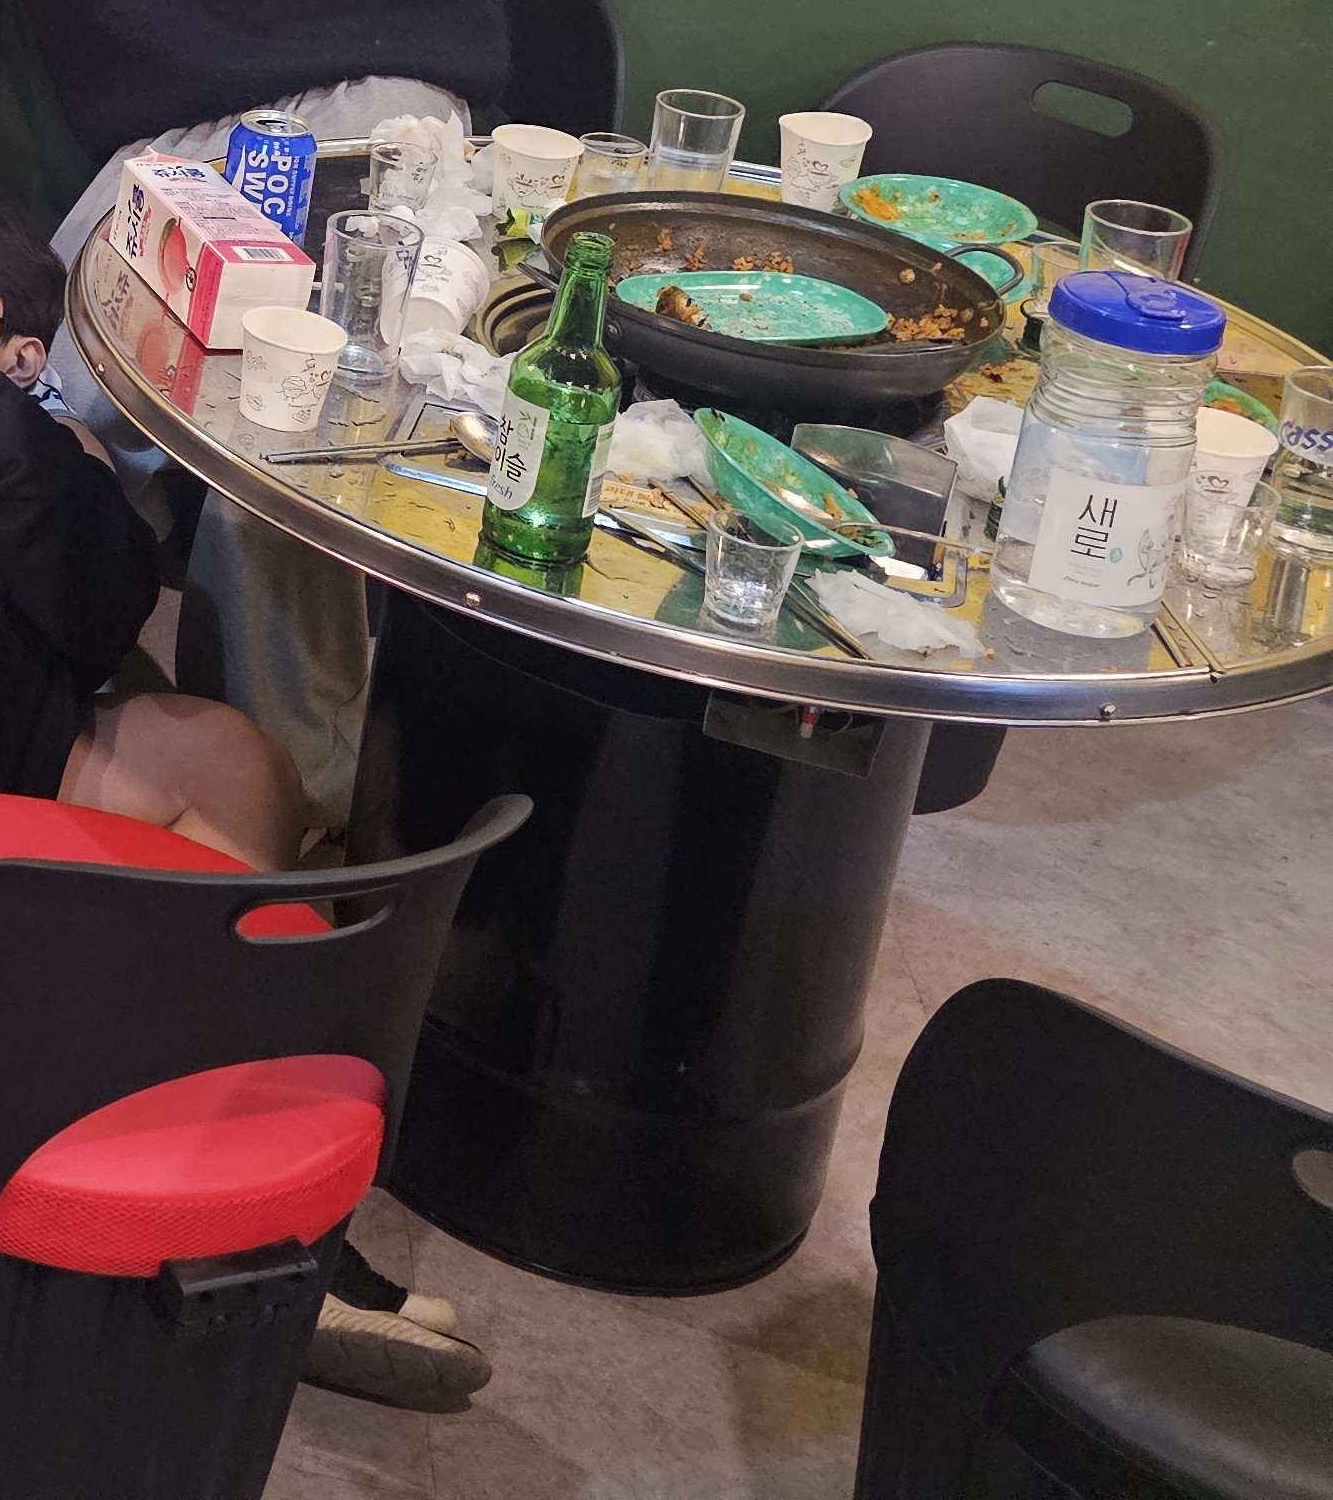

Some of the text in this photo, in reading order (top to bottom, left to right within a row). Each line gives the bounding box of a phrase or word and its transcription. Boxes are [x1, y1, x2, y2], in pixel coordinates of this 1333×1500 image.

[125, 182, 146, 259] 쥬시쿨
[488, 474, 514, 500] fresh
[1070, 493, 1119, 560] 새로
